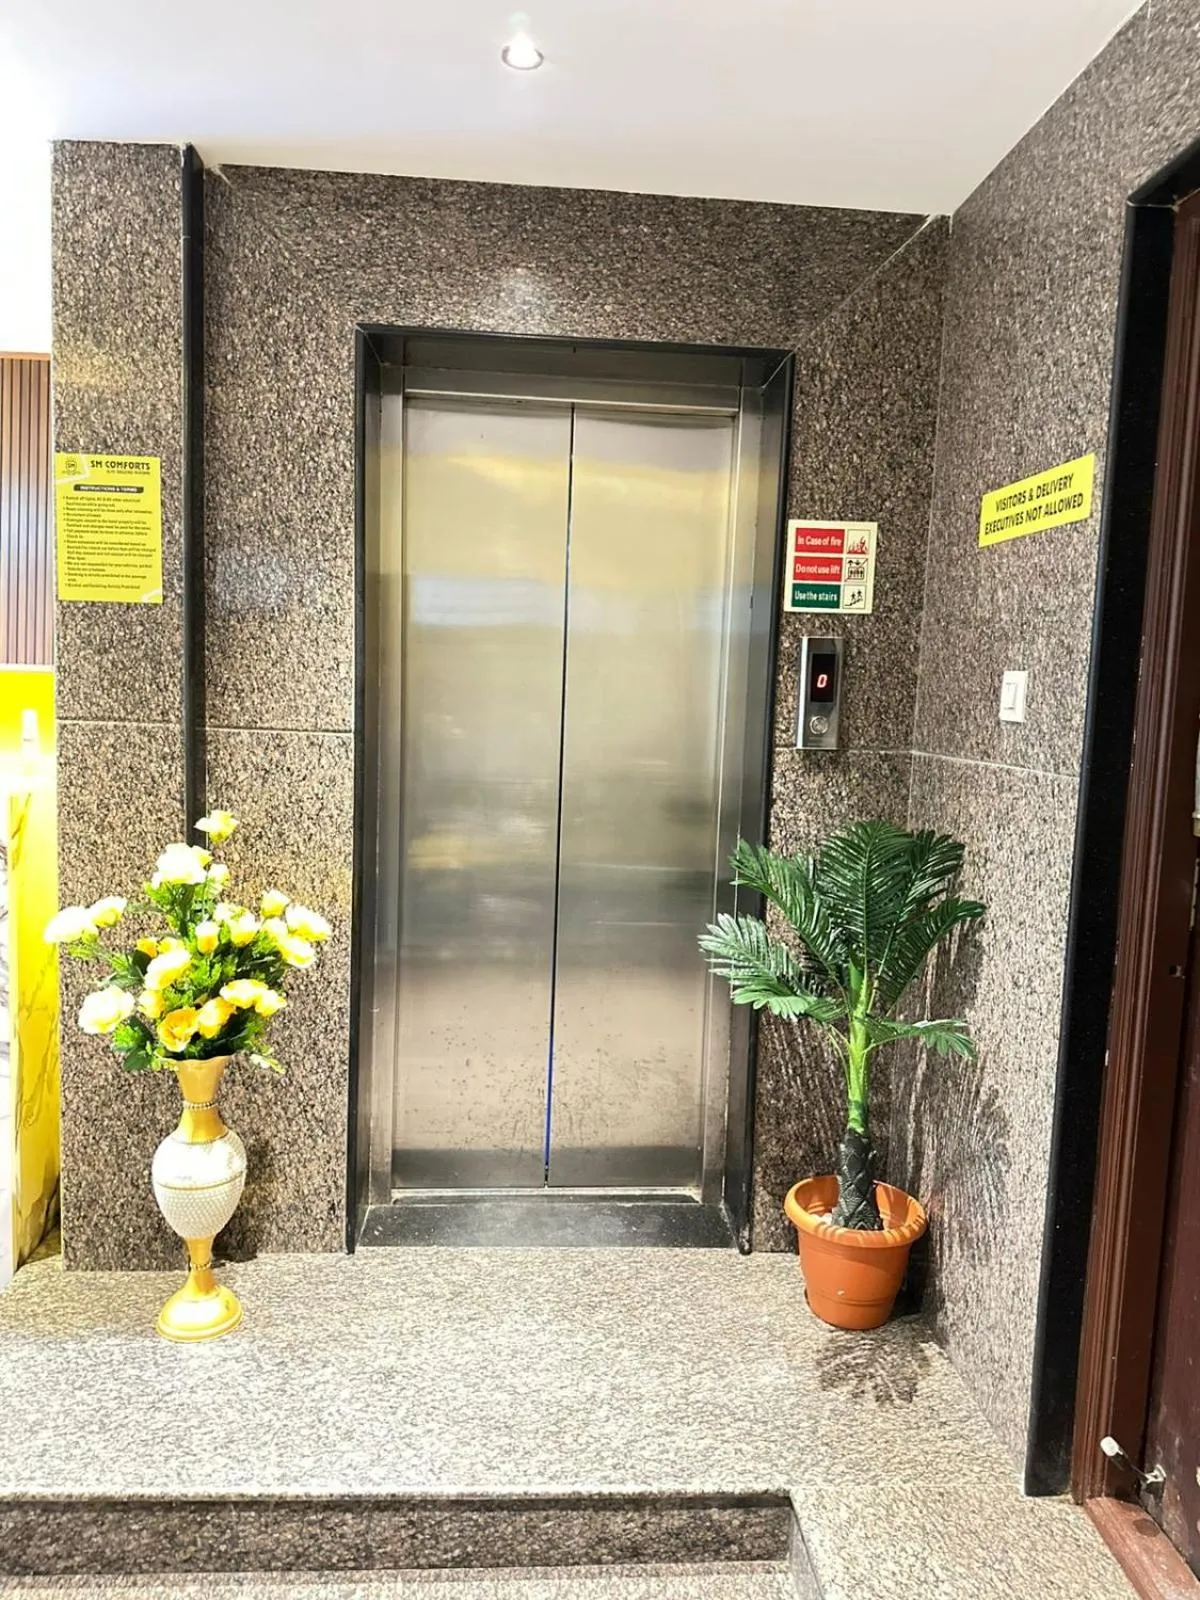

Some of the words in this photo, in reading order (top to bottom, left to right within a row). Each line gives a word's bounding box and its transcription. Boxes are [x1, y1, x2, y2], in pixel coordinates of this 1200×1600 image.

[91, 460, 102, 468] SM
[105, 461, 150, 470] COMFORTS
[995, 490, 1026, 512] VISITORS
[1028, 488, 1034, 501] &
[1036, 472, 1074, 499] DELIVERY
[985, 511, 1024, 536] EXECUTIVES
[1025, 505, 1042, 523] NOT
[1043, 492, 1084, 518] ALLOWED
[797, 536, 804, 545] In
[806, 536, 821, 545] Case
[821, 536, 830, 545] of
[830, 536, 842, 546] fire
[796, 564, 806, 573] Do
[806, 565, 817, 573] not
[818, 566, 829, 574] use
[830, 565, 840, 574] lift
[794, 590, 805, 600] Use
[805, 591, 817, 600] the
[818, 591, 838, 601] stairs
[817, 674, 828, 688] 0
